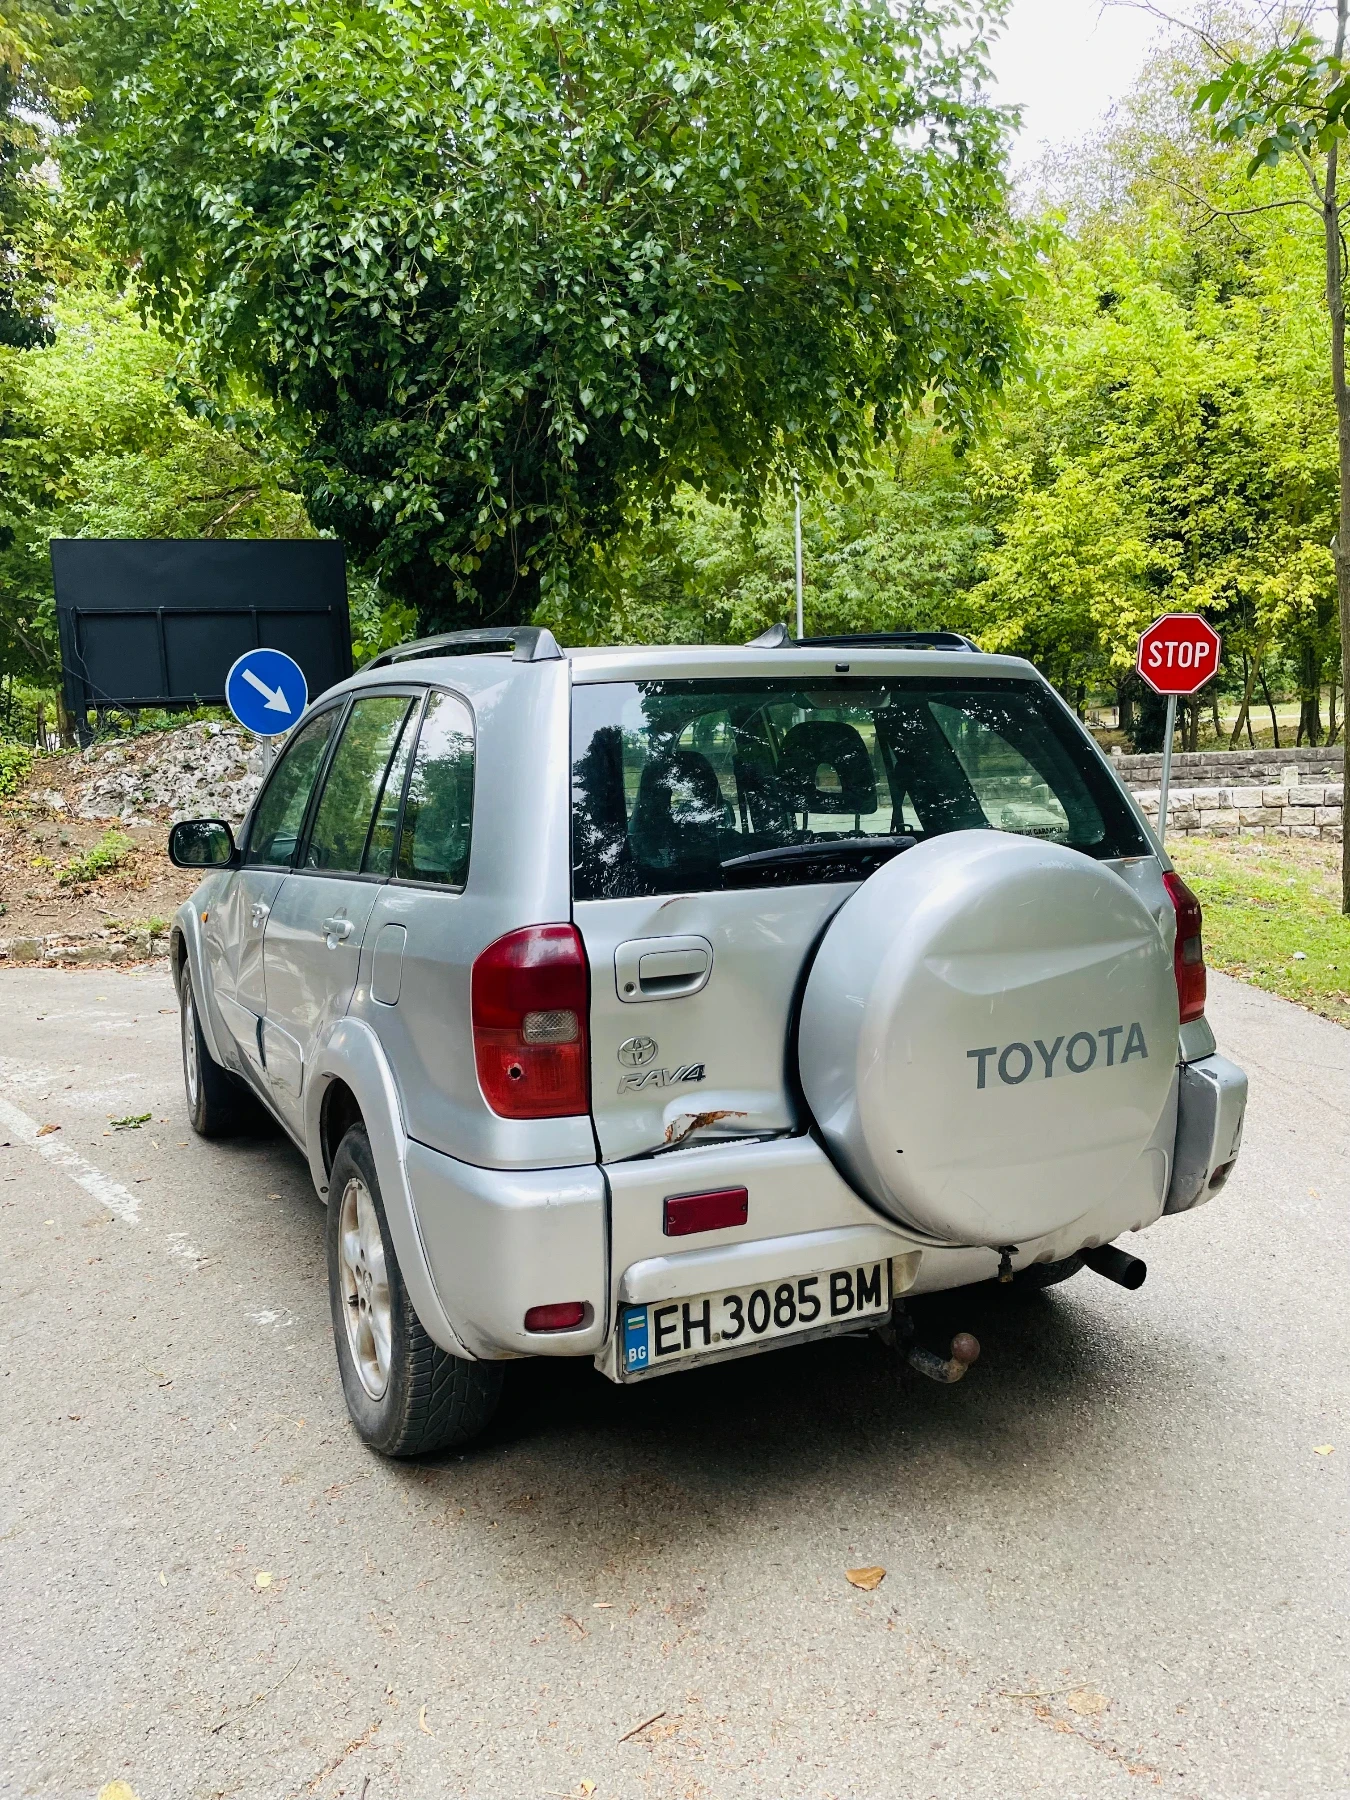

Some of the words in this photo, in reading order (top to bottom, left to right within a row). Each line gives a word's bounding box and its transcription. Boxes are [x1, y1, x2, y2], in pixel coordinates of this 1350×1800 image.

[1148, 641, 1210, 668] STOP
[966, 1021, 1149, 1089] TOYOTA
[617, 1063, 707, 1094] RAV4
[653, 1299, 711, 1357] EH
[721, 1276, 821, 1341] 3085
[829, 1264, 882, 1318] BM
[628, 1345, 647, 1363] BG
